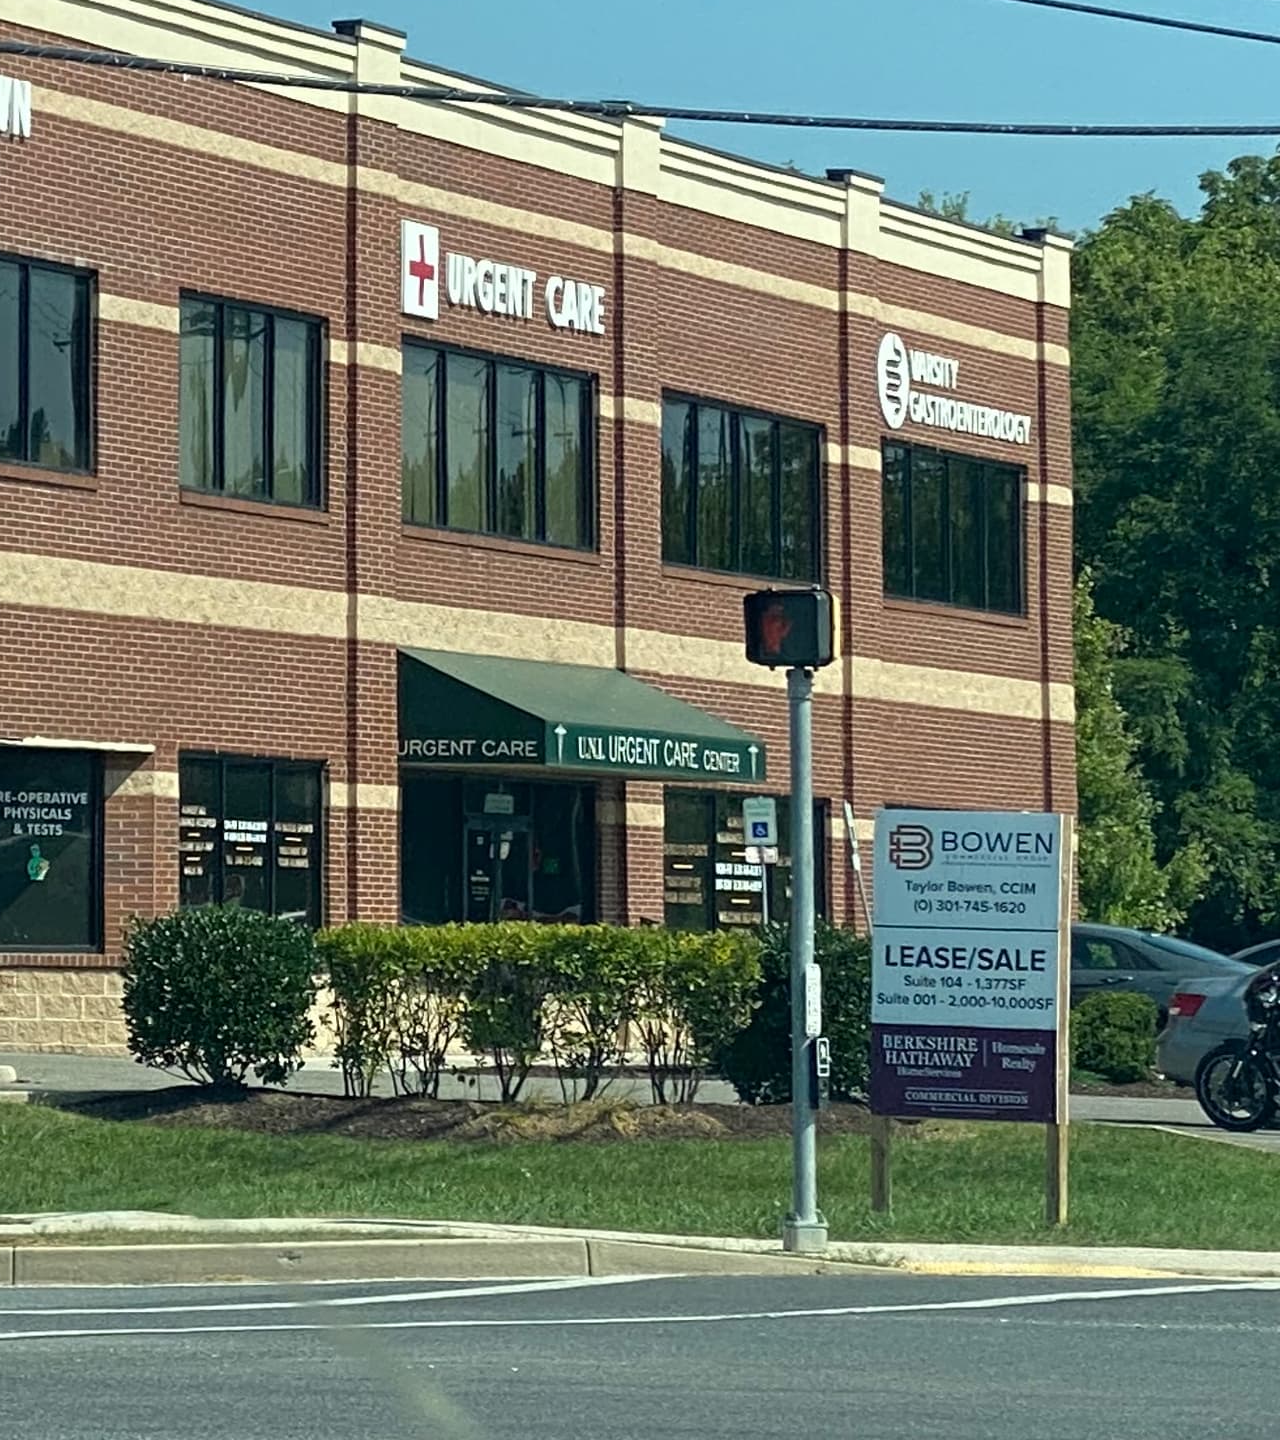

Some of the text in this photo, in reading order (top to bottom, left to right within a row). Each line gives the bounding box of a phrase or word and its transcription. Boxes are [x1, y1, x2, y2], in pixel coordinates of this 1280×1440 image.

[446, 251, 606, 335] URGENT CARE
[909, 391, 1032, 445] GASTROENTEROLOGY
[396, 739, 538, 758] URGENT CARE
[609, 735, 659, 766] URGENT
[664, 741, 699, 769] CARE
[703, 749, 740, 773] CENTER
[3, 807, 72, 820] PHYSICALS
[13, 823, 63, 836] & TESTS
[942, 831, 1053, 854] BOWEN
[905, 880, 1036, 895] Taylor Bowen, CCIM
[936, 900, 1026, 914] 301-745-1620
[885, 945, 1046, 972] LEASE/SALE
[904, 975, 936, 988] Suite
[941, 976, 963, 988] 104
[877, 992, 910, 1005] Suite
[913, 993, 937, 1006] 001
[883, 1034, 978, 1053] BERKSHIRE
[886, 1050, 975, 1068] HATHAWAY
[1002, 1057, 1037, 1072] Realty
[904, 1091, 1029, 1105] COMMERCIAL DIVISION
